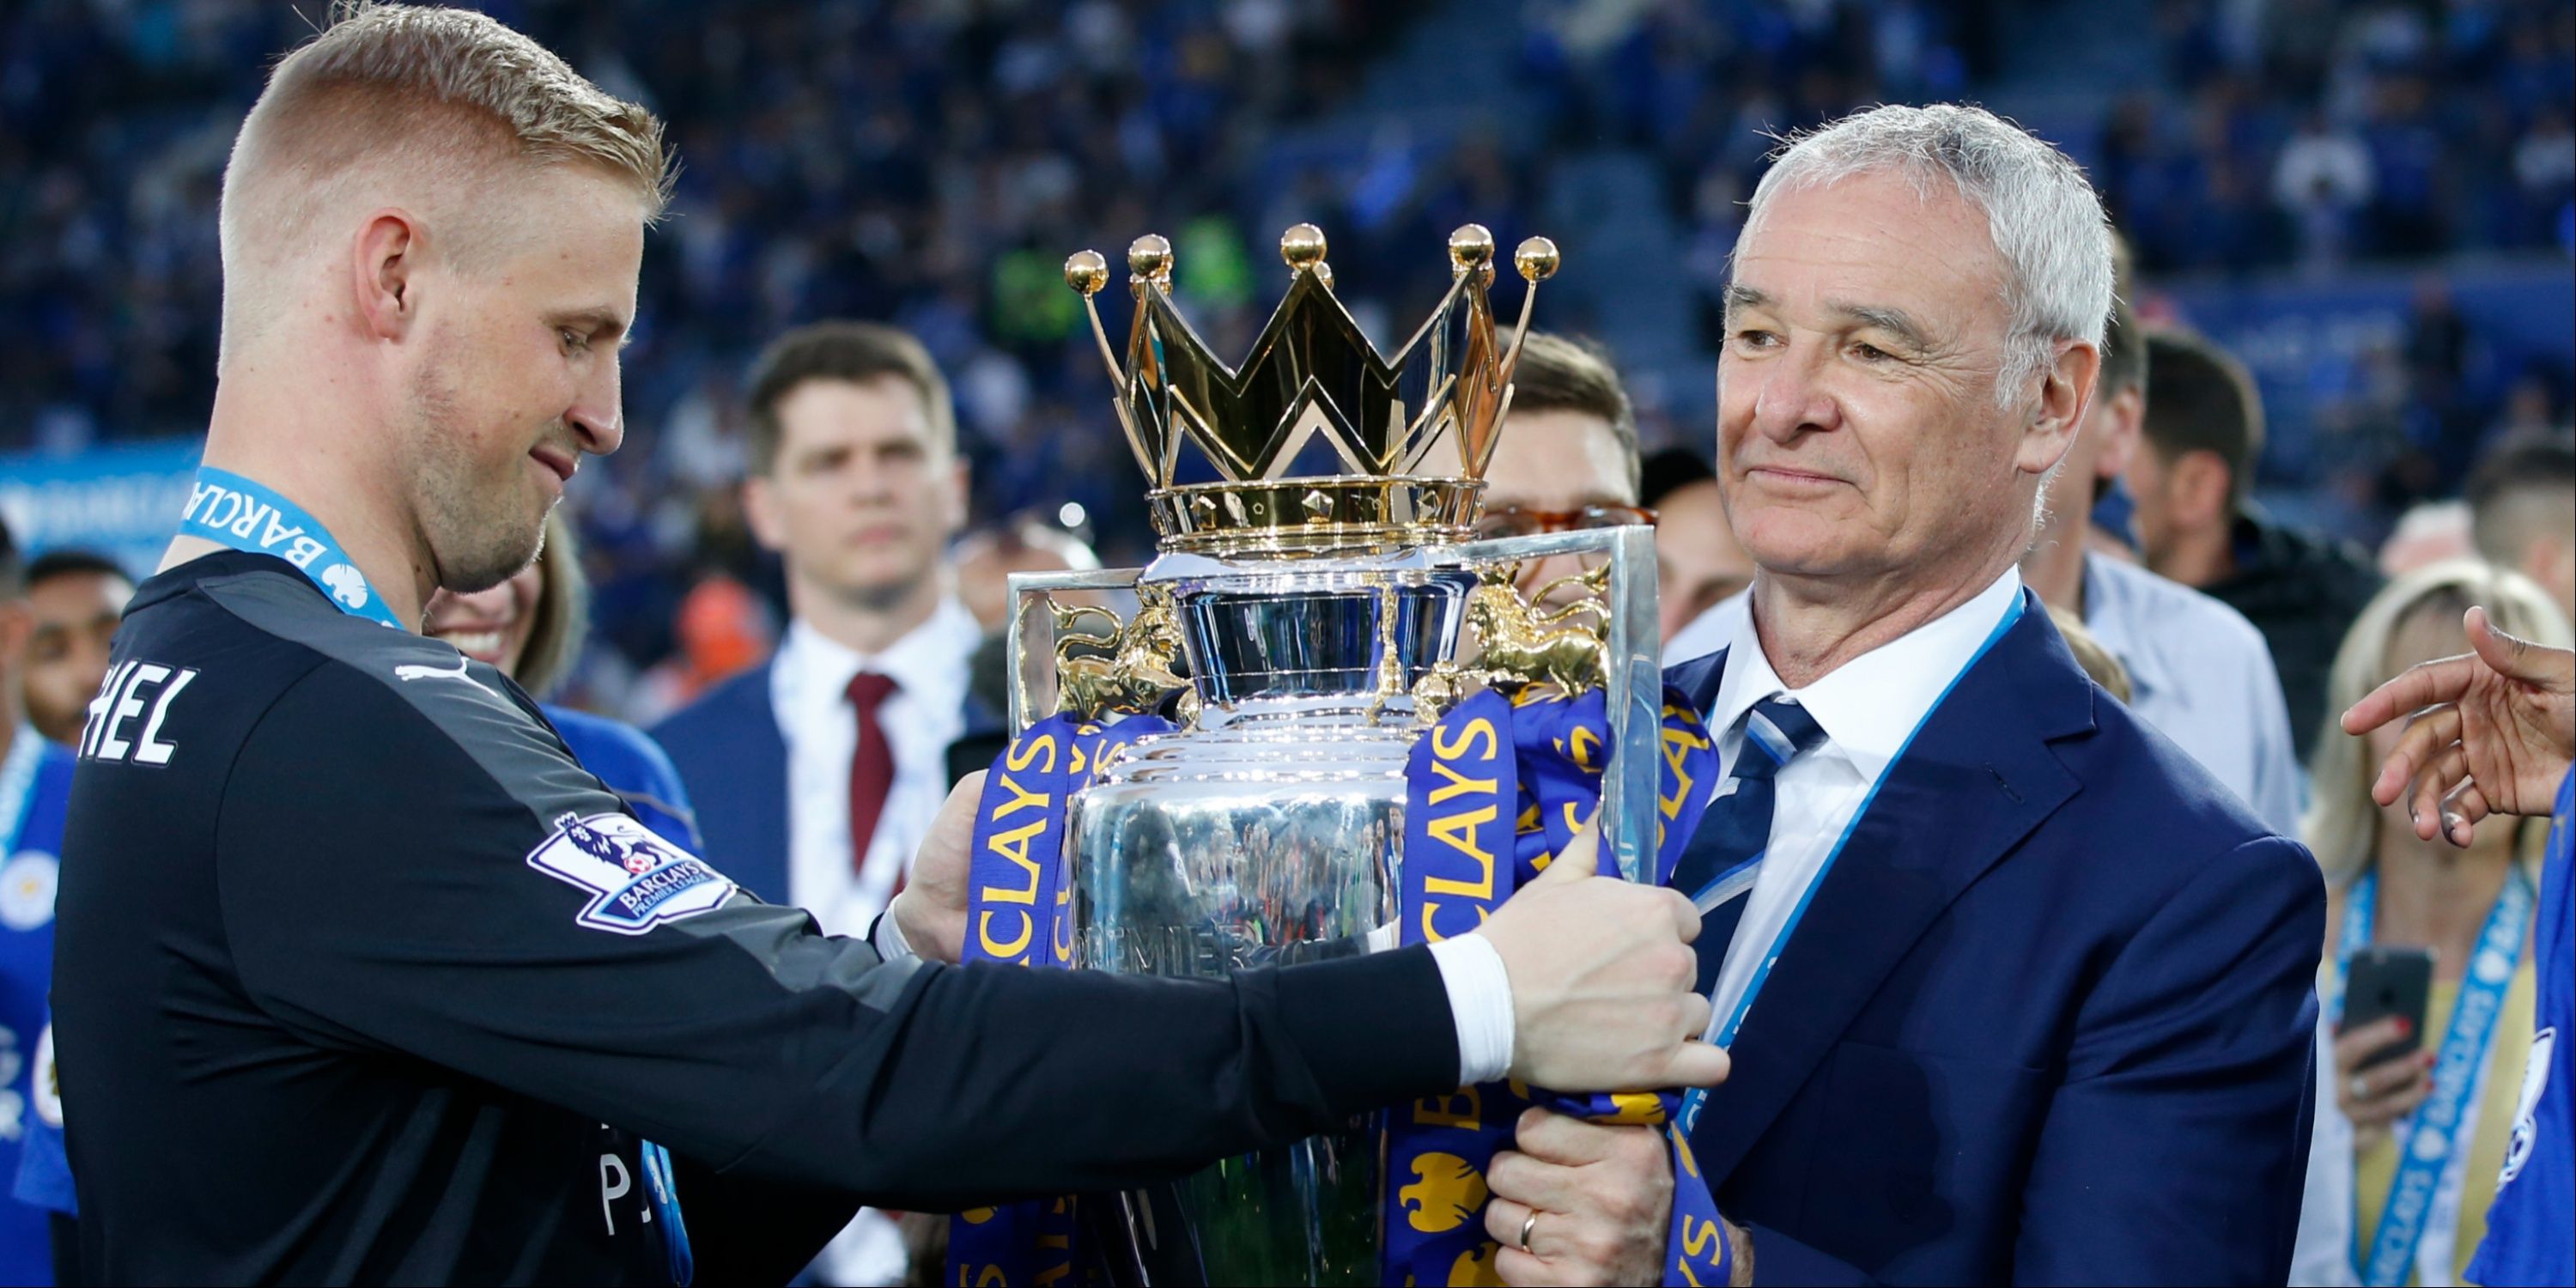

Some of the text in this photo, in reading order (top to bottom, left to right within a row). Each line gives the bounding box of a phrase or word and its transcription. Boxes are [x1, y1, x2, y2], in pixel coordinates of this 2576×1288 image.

[78, 660, 197, 764] HEL
[619, 861, 701, 909] BARCLAYS
[979, 734, 1057, 969] CLAYS
[632, 884, 677, 918] PREMIER
